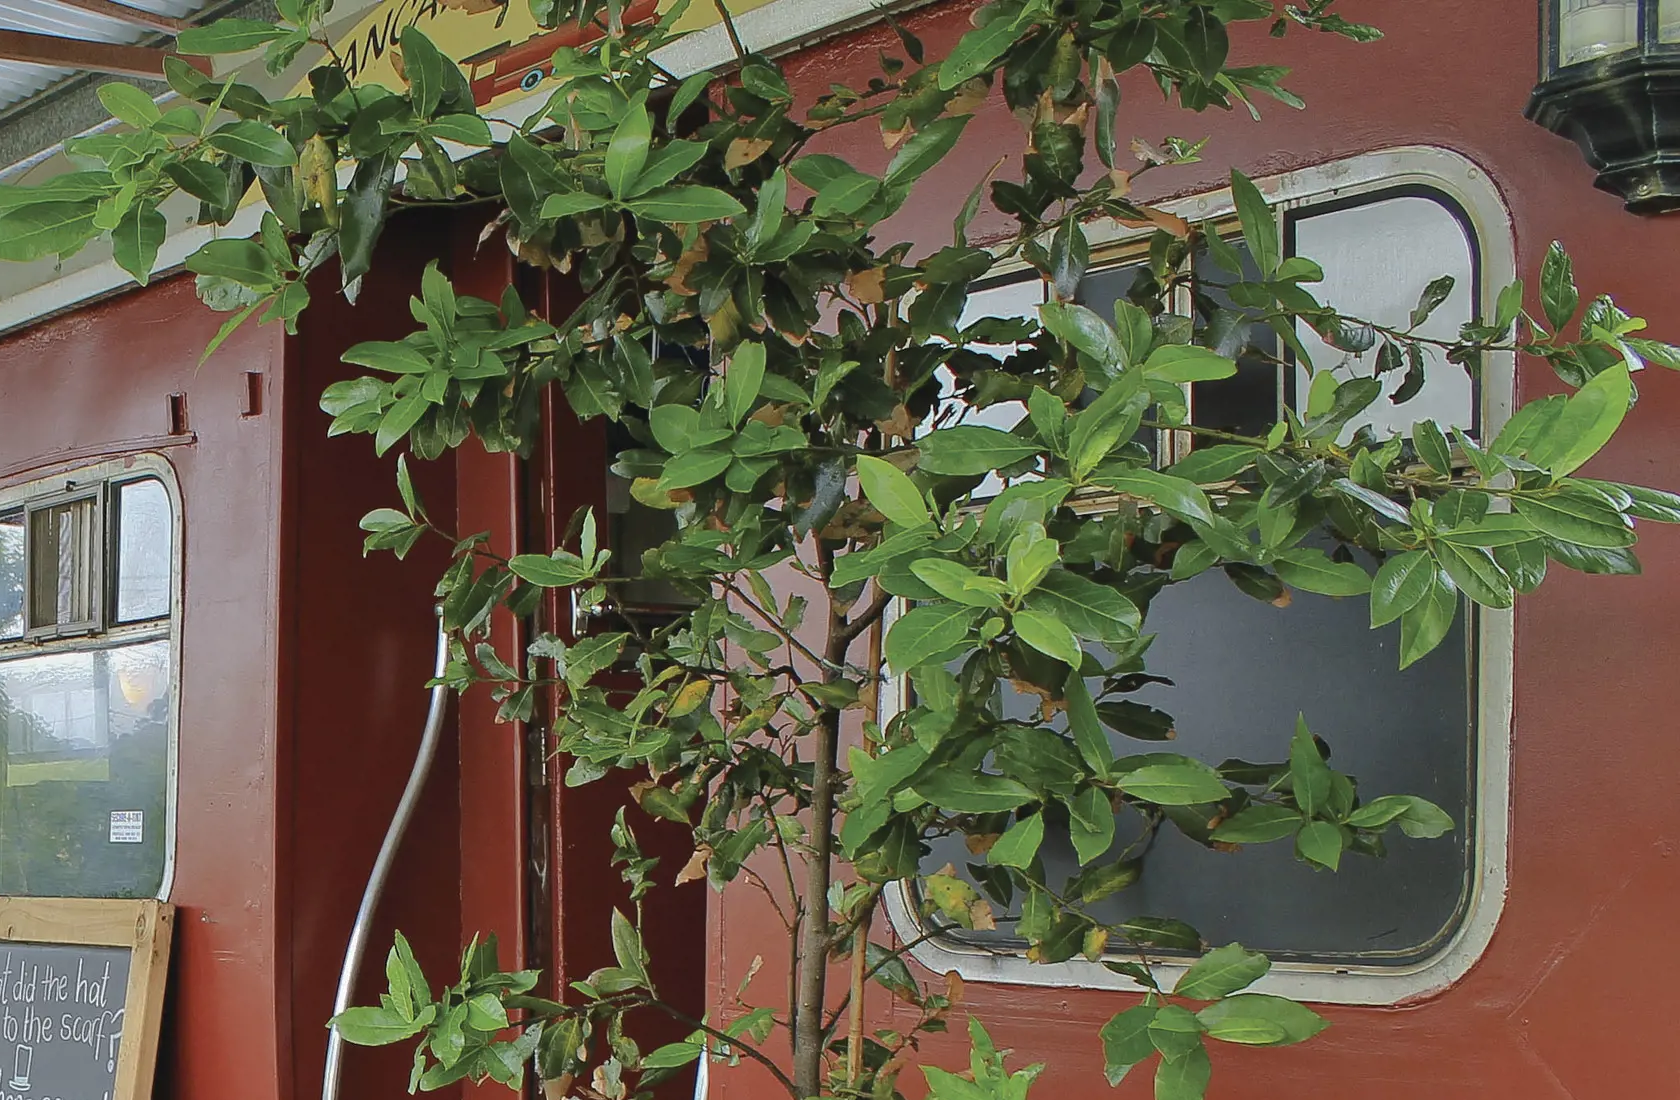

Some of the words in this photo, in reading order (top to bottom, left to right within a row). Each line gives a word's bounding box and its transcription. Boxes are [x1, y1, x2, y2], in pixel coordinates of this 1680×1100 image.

[13, 960, 38, 1003] did
[41, 964, 69, 1002] the
[75, 957, 110, 1008] hat
[3, 1006, 19, 1042] to
[23, 1005, 53, 1043] the
[60, 1008, 125, 1073] scarf?
